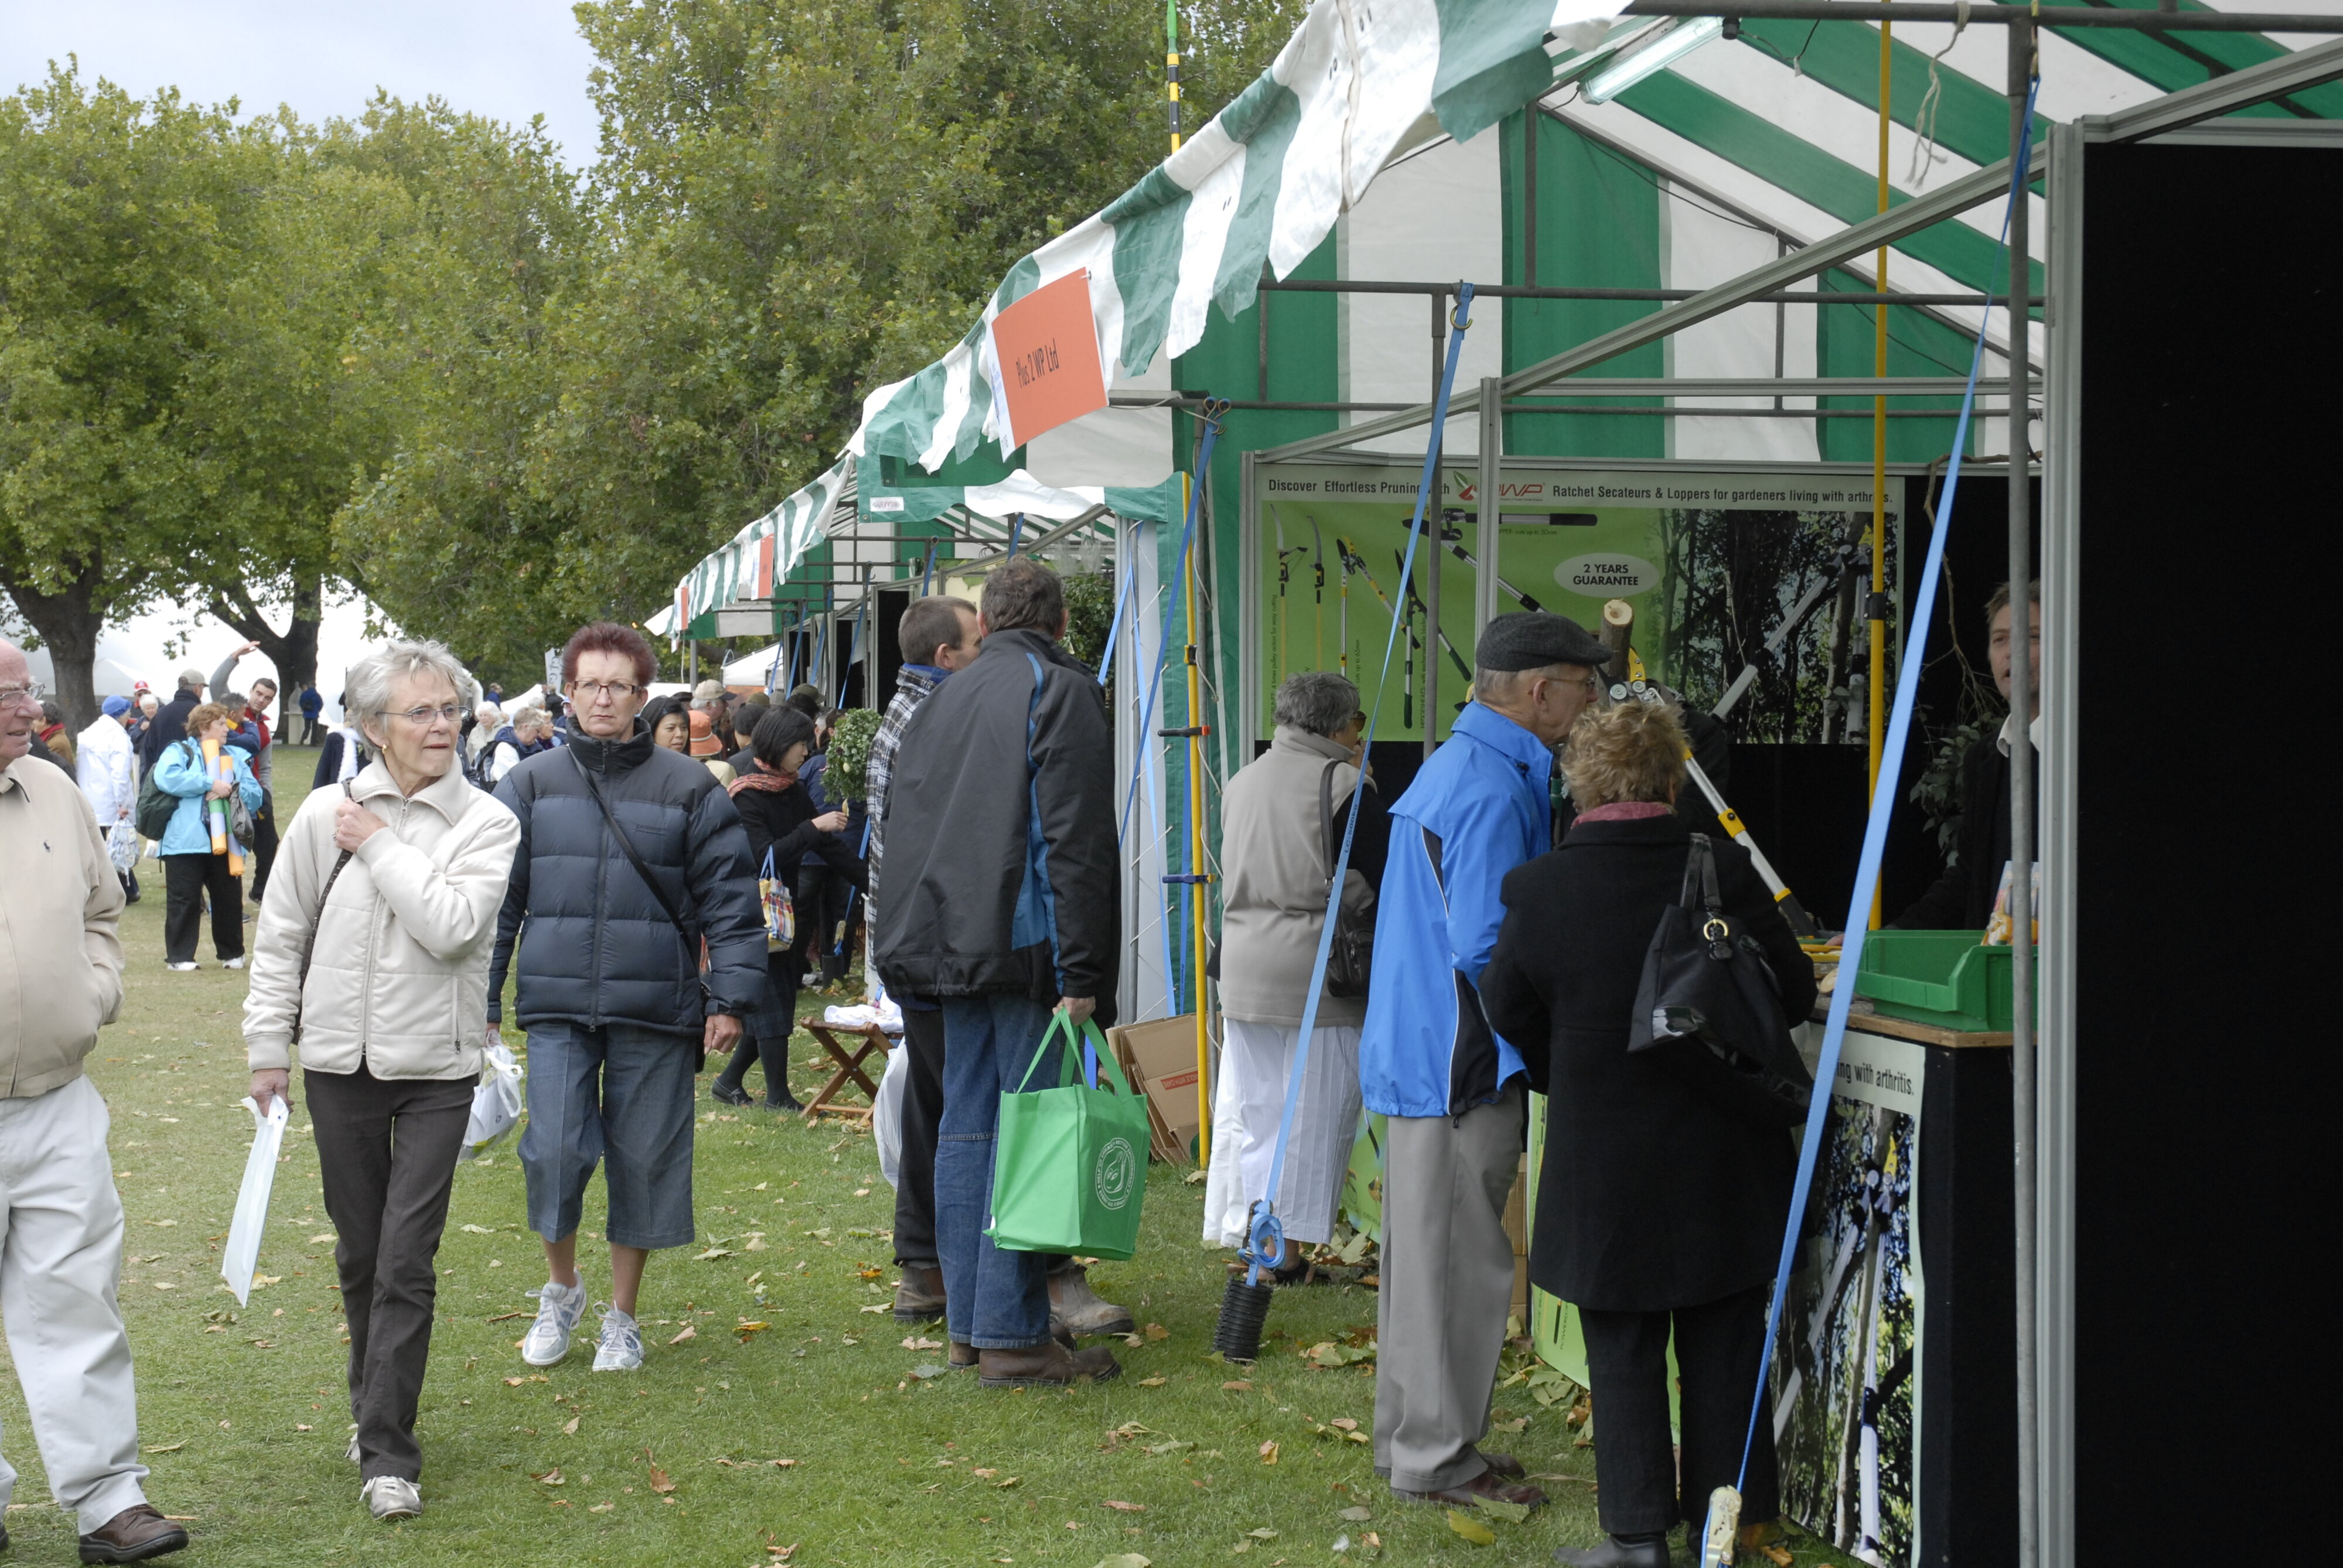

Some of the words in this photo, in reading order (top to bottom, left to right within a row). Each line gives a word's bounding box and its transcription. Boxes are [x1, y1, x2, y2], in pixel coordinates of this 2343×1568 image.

[1016, 357, 1029, 389] Plus
[1028, 354, 1035, 381] 2
[1032, 347, 1045, 378] WP
[1045, 338, 1059, 373] Ltd
[1268, 479, 1317, 491] Discover
[1325, 480, 1376, 493] Effortless
[1553, 486, 1594, 497] Ratchet
[1598, 486, 1651, 498] Secateurs
[1655, 487, 1663, 498] &
[1667, 488, 1710, 501] Loppers
[1714, 488, 1728, 500] for
[1732, 490, 1786, 503] gardeners
[1789, 490, 1817, 504] living
[1822, 490, 1844, 502] with
[1583, 563, 1591, 573] 2
[1594, 564, 1629, 573] YEARS
[1573, 575, 1639, 585] GUARANTEE
[1854, 1062, 1873, 1085] with
[1876, 1069, 1914, 1095] arthritis.
